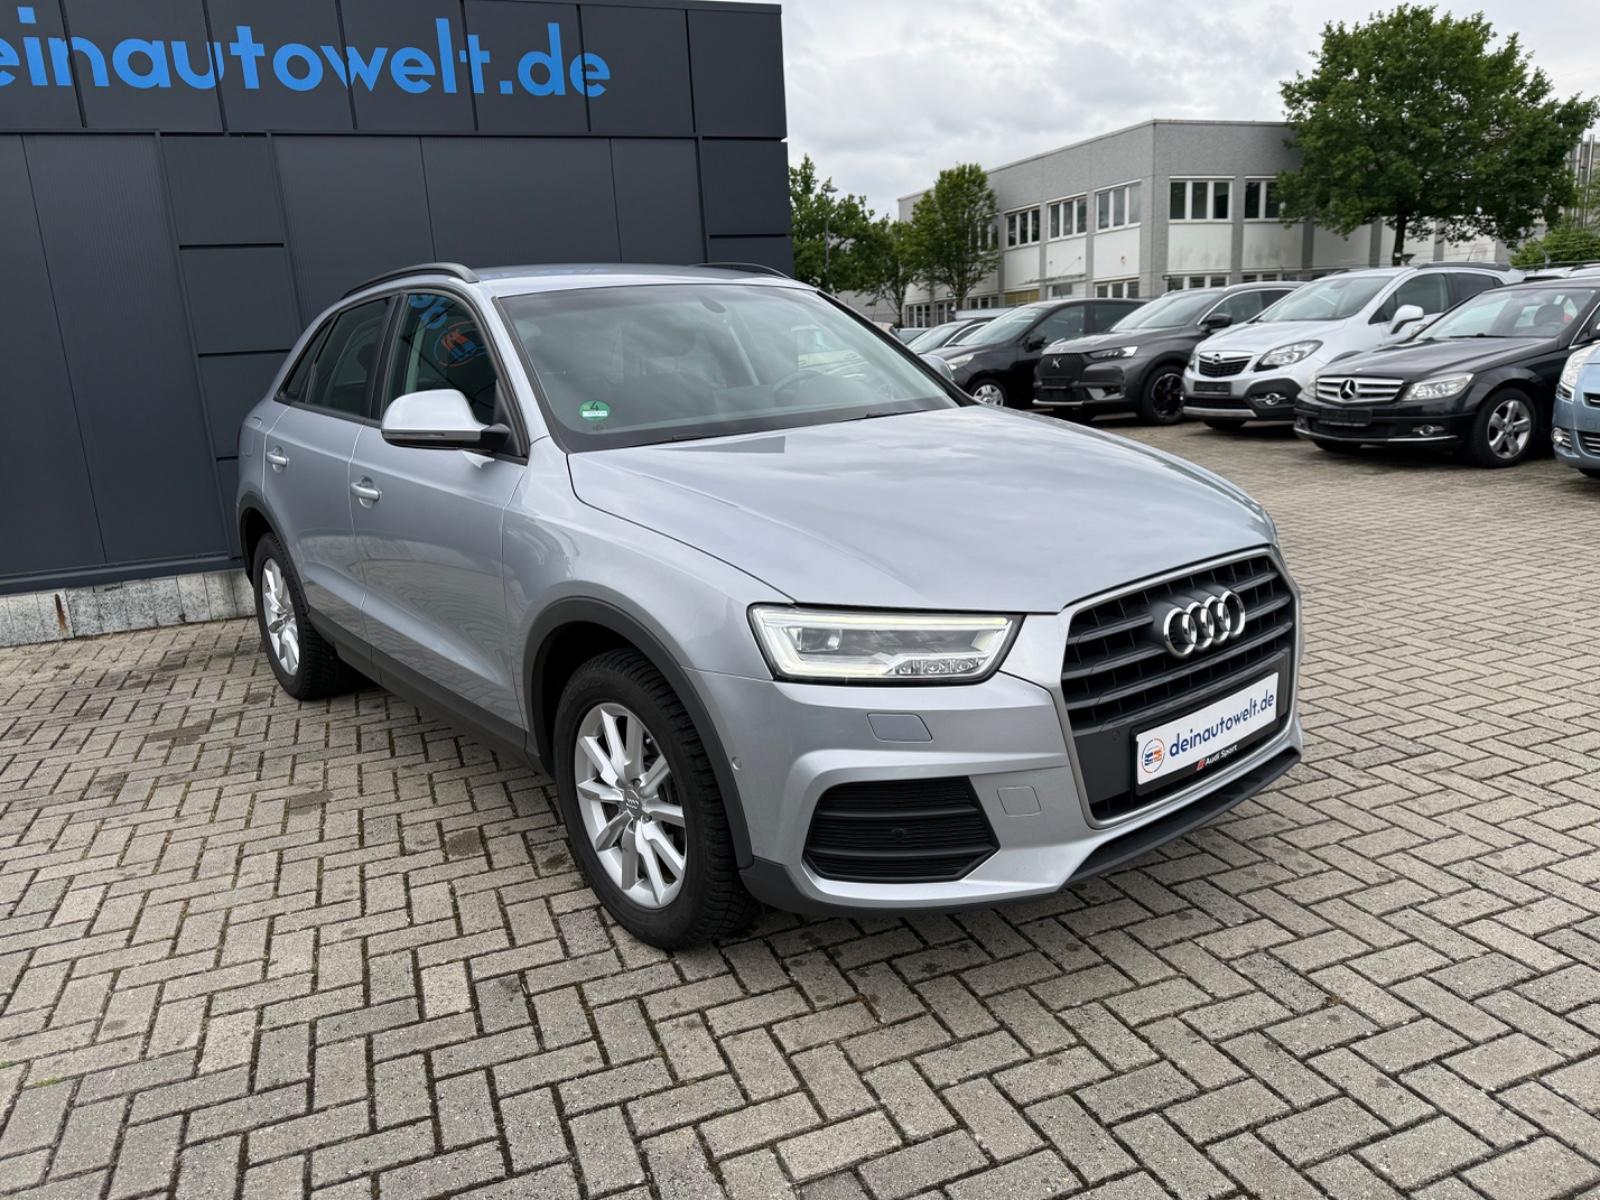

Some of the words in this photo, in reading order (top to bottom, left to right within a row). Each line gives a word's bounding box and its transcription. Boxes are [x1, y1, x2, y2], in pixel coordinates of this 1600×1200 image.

[590, 400, 600, 411] 4
[1169, 689, 1275, 758] deinautowelt.de
[1205, 751, 1220, 767] Audi
[1220, 744, 1238, 759] Sport
